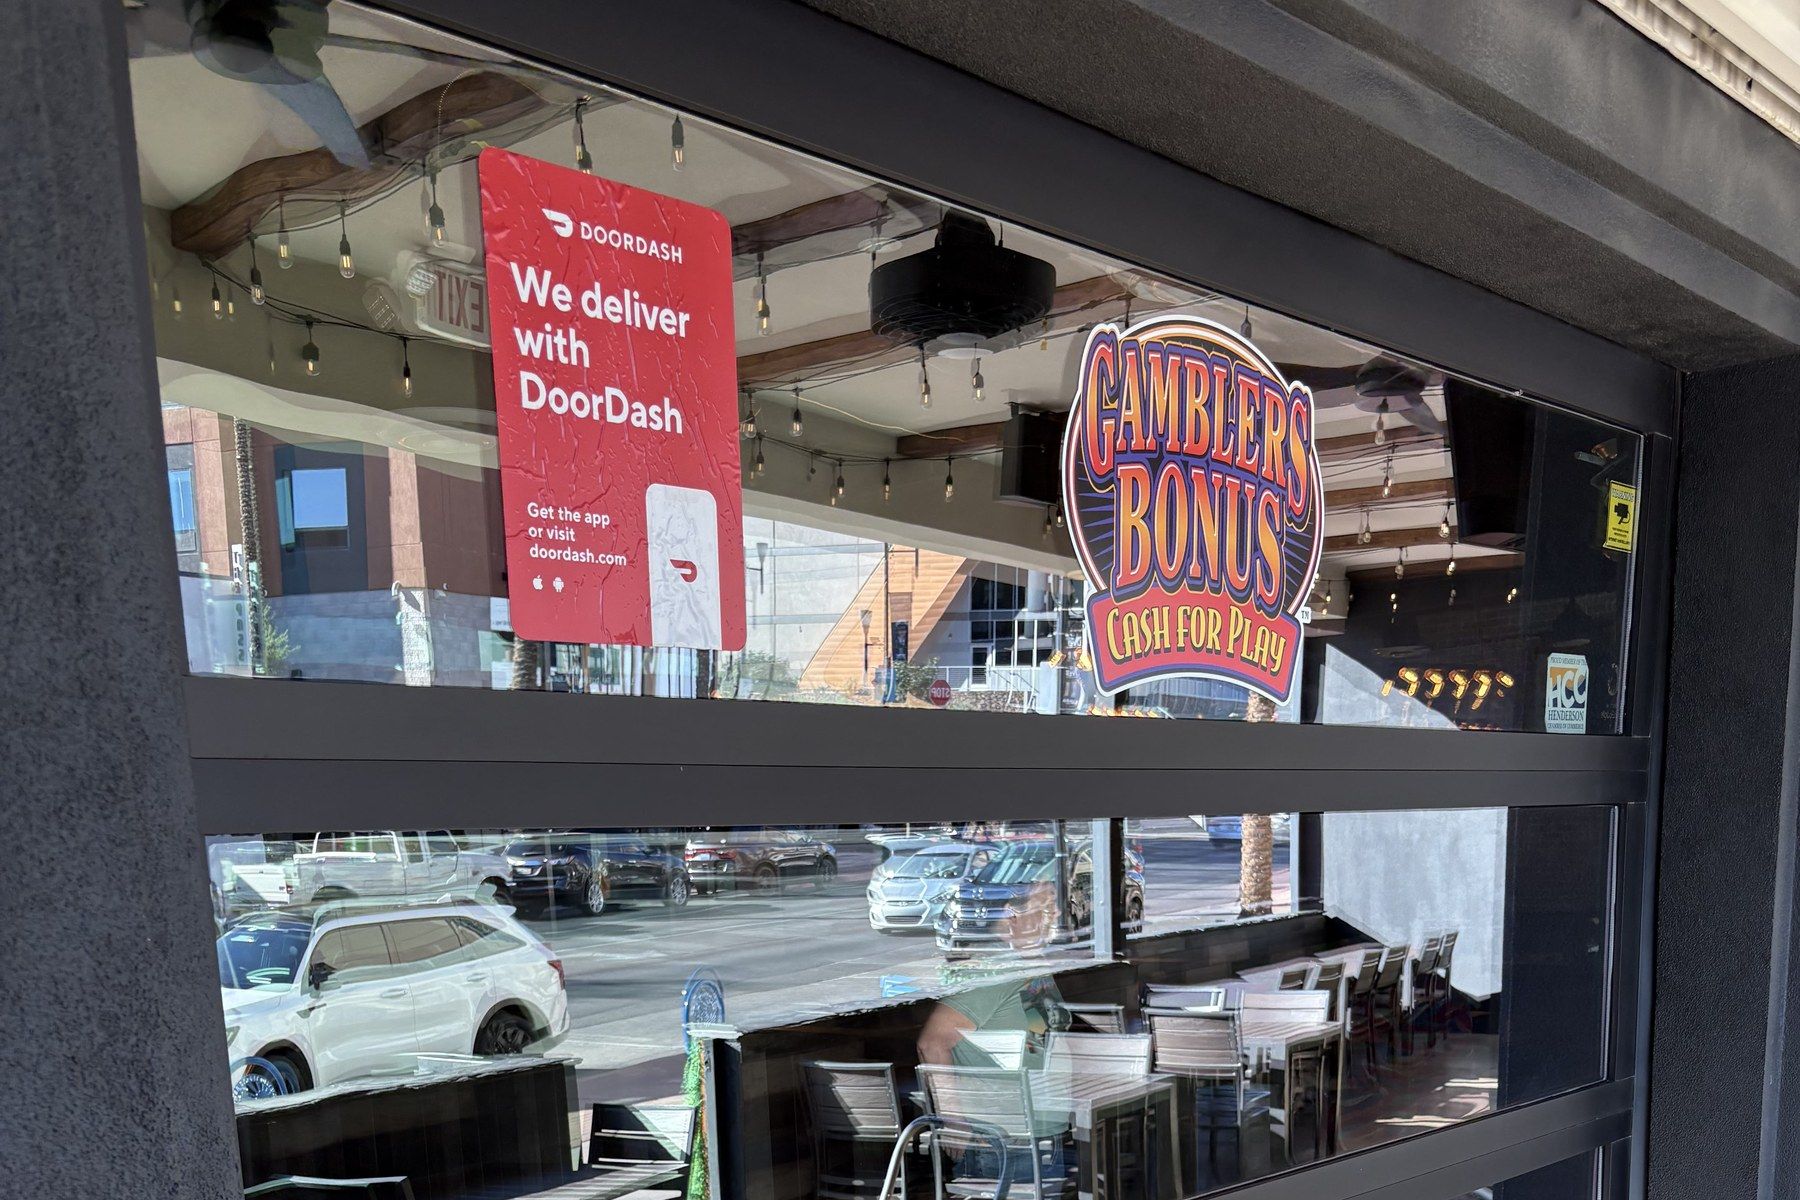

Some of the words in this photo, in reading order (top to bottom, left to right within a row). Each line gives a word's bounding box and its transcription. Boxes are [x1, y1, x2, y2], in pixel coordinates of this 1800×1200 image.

[580, 221, 683, 264] DOORDASH
[510, 261, 573, 312] We
[581, 281, 690, 338] deliver
[513, 322, 590, 368] with
[519, 370, 684, 434] DoorDash
[1086, 341, 1310, 518] GAMBLERS
[527, 501, 555, 521] Get
[558, 506, 581, 523] the
[584, 511, 610, 530] app
[528, 526, 543, 538] or
[546, 525, 576, 542] visit
[1114, 460, 1282, 607] BONUS
[529, 543, 627, 566] doordash.com
[1106, 605, 1172, 664] CASH
[1176, 604, 1222, 655] FOR
[1228, 604, 1288, 676] PLAY
[1547, 667, 1587, 709] HCC
[1547, 709, 1585, 722] HENDERSON
